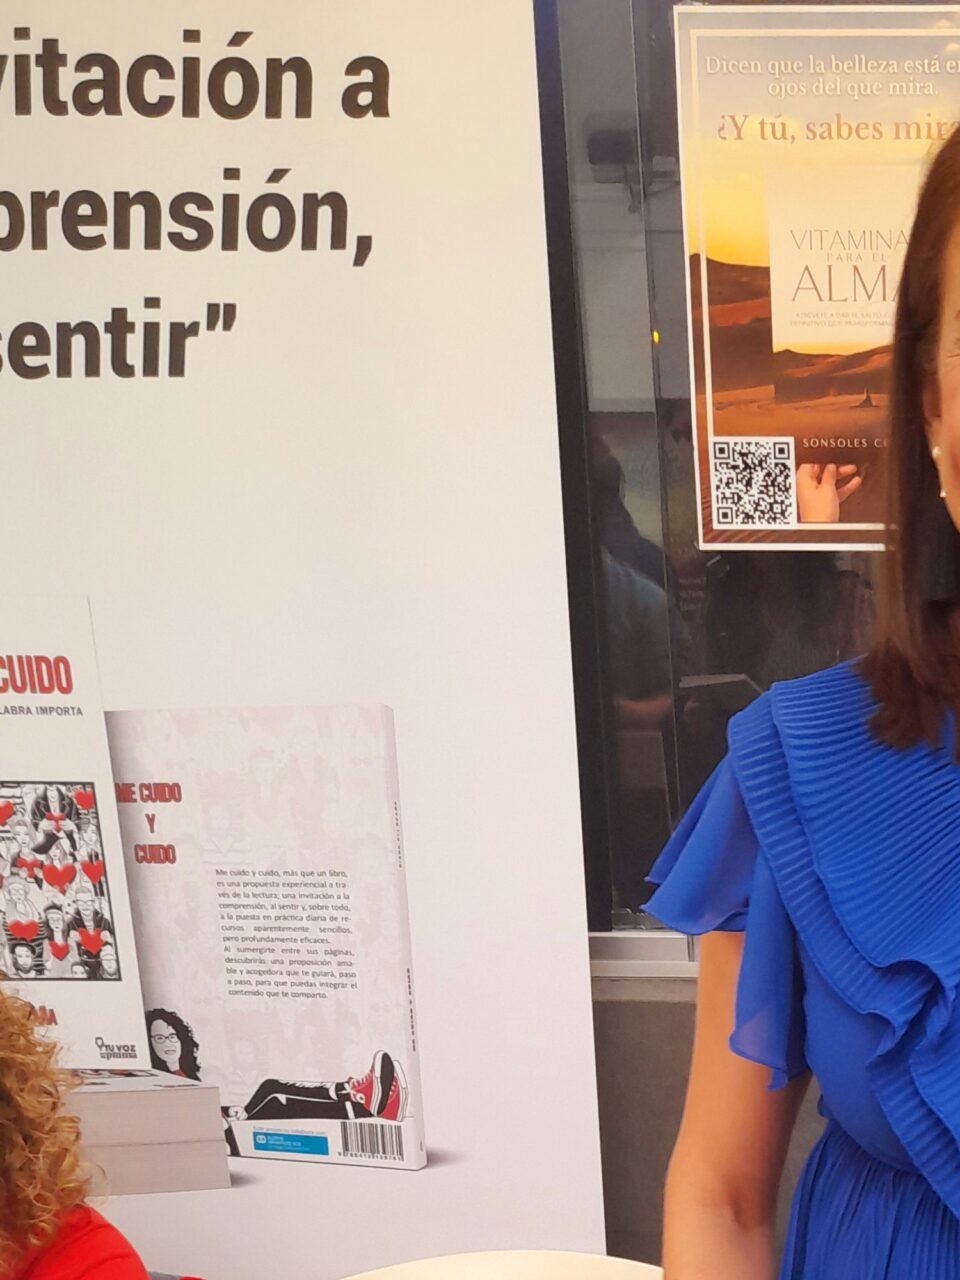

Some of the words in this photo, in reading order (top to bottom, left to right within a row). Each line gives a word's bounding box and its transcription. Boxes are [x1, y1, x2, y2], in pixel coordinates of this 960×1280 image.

[0, 27, 312, 120] itación
[341, 55, 390, 118] a
[705, 56, 762, 74] Dicen
[768, 60, 803, 80] que
[809, 56, 826, 73] la
[831, 56, 898, 73] belleza
[904, 55, 940, 73] está
[768, 77, 806, 100] ojos
[812, 77, 842, 95] del
[847, 81, 882, 101] que
[888, 78, 938, 96] mira.
[718, 115, 749, 141] ¿Y
[759, 113, 796, 143] tú,
[806, 114, 883, 141] sabes
[827, 253, 862, 262] PARA
[873, 253, 886, 262] EL
[0, 297, 237, 379] entir"
[803, 439, 867, 447] SONSOLES
[36, 707, 83, 716] IMPORTA
[139, 783, 182, 802] CUIDO
[145, 814, 155, 833] Y
[134, 844, 176, 864] CUIDO
[117, 1044, 136, 1052] VOZ
